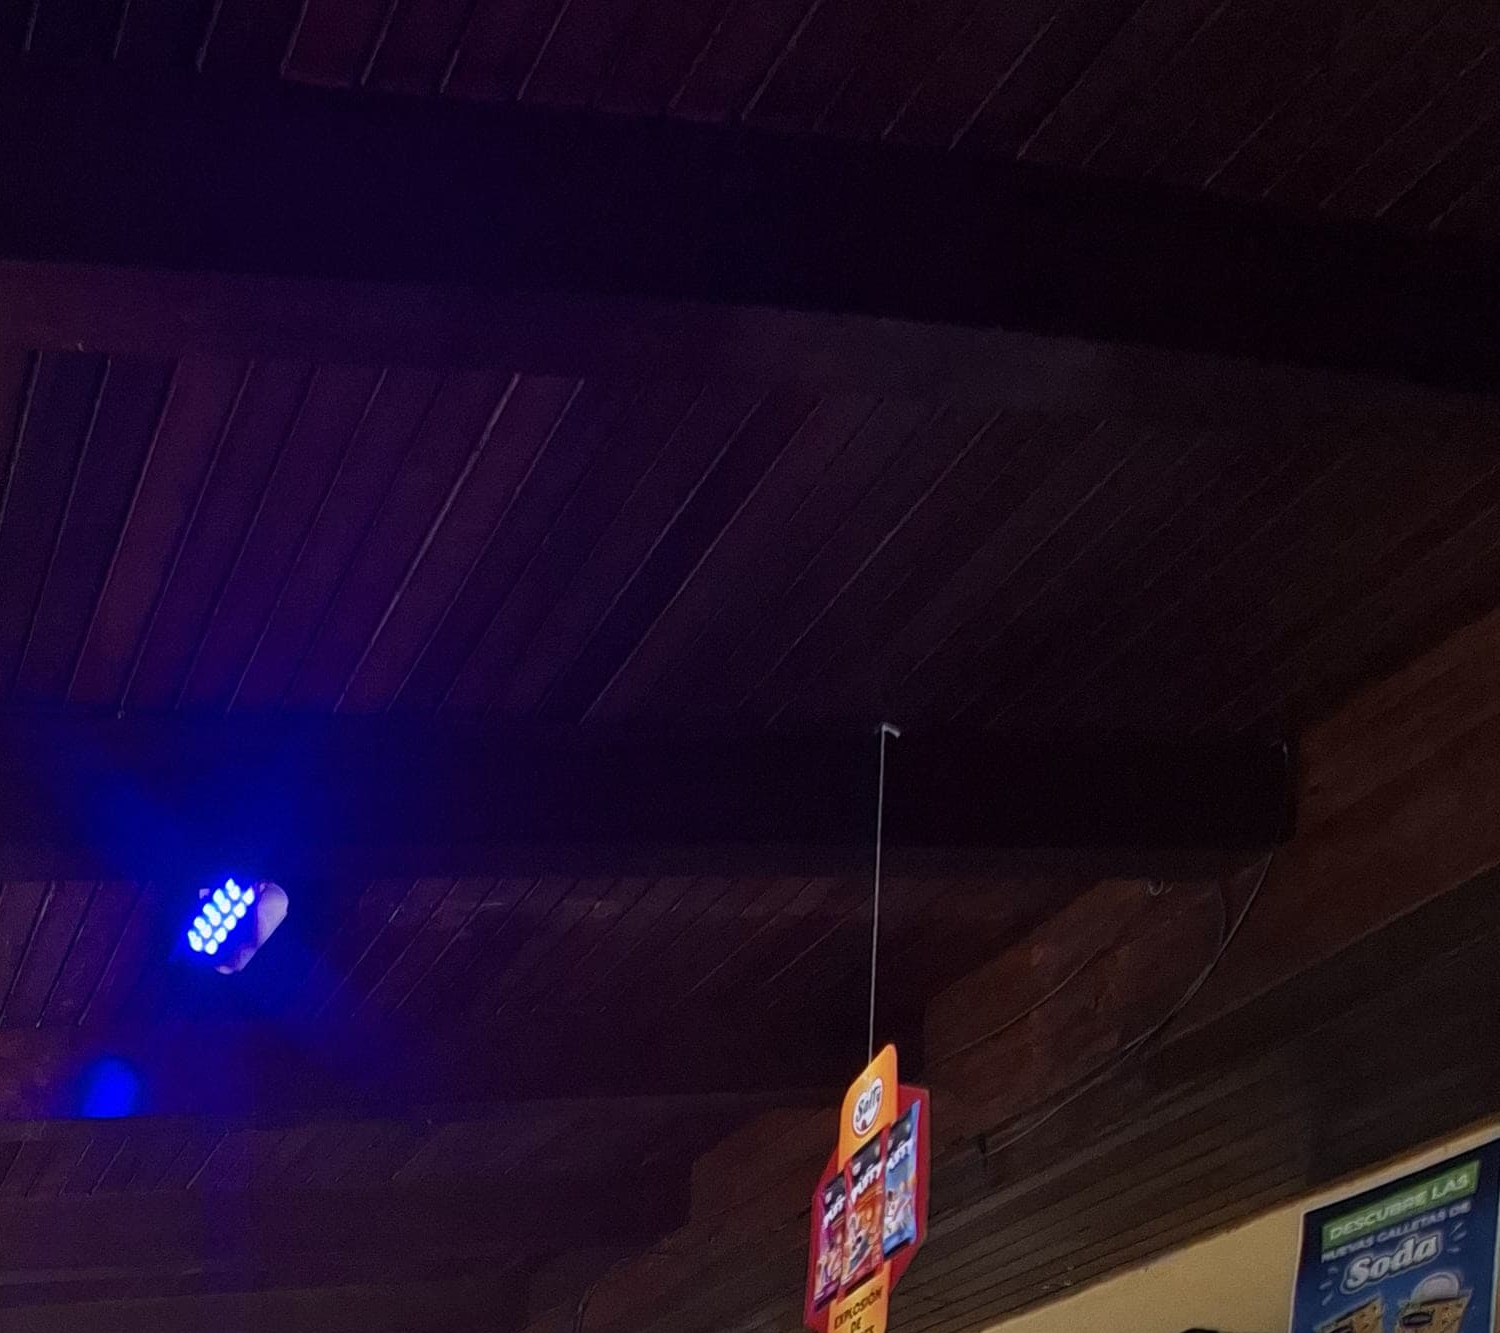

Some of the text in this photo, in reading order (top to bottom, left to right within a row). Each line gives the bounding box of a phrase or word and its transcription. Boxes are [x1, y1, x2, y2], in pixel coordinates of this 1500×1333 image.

[1329, 1174, 1468, 1241] DESCUBRE LAS
[1345, 1236, 1438, 1288] Soda
